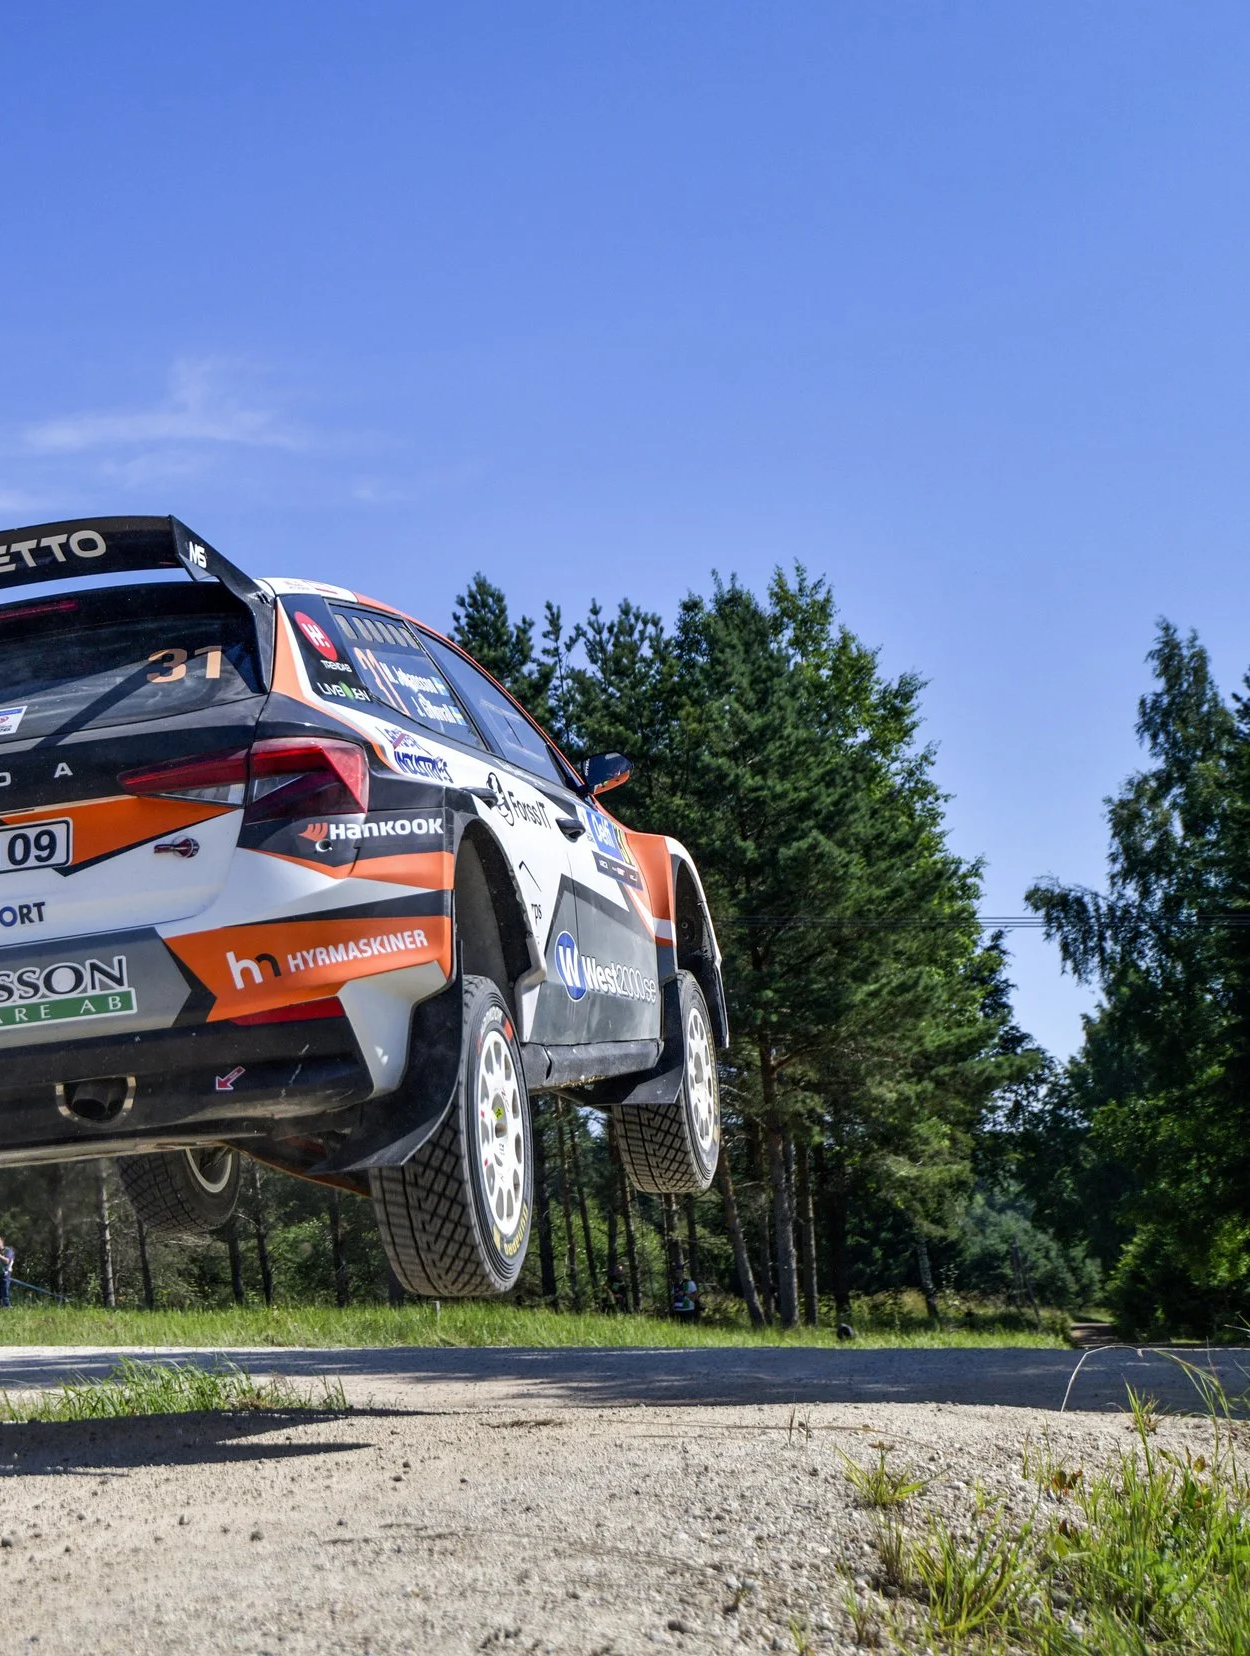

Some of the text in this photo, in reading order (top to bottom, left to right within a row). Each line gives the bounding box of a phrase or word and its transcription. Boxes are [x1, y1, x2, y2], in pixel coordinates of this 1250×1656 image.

[189, 540, 207, 569] MS
[146, 645, 223, 684] 31
[287, 929, 429, 973] HYRMASKINER
[79, 996, 124, 1015] AB
